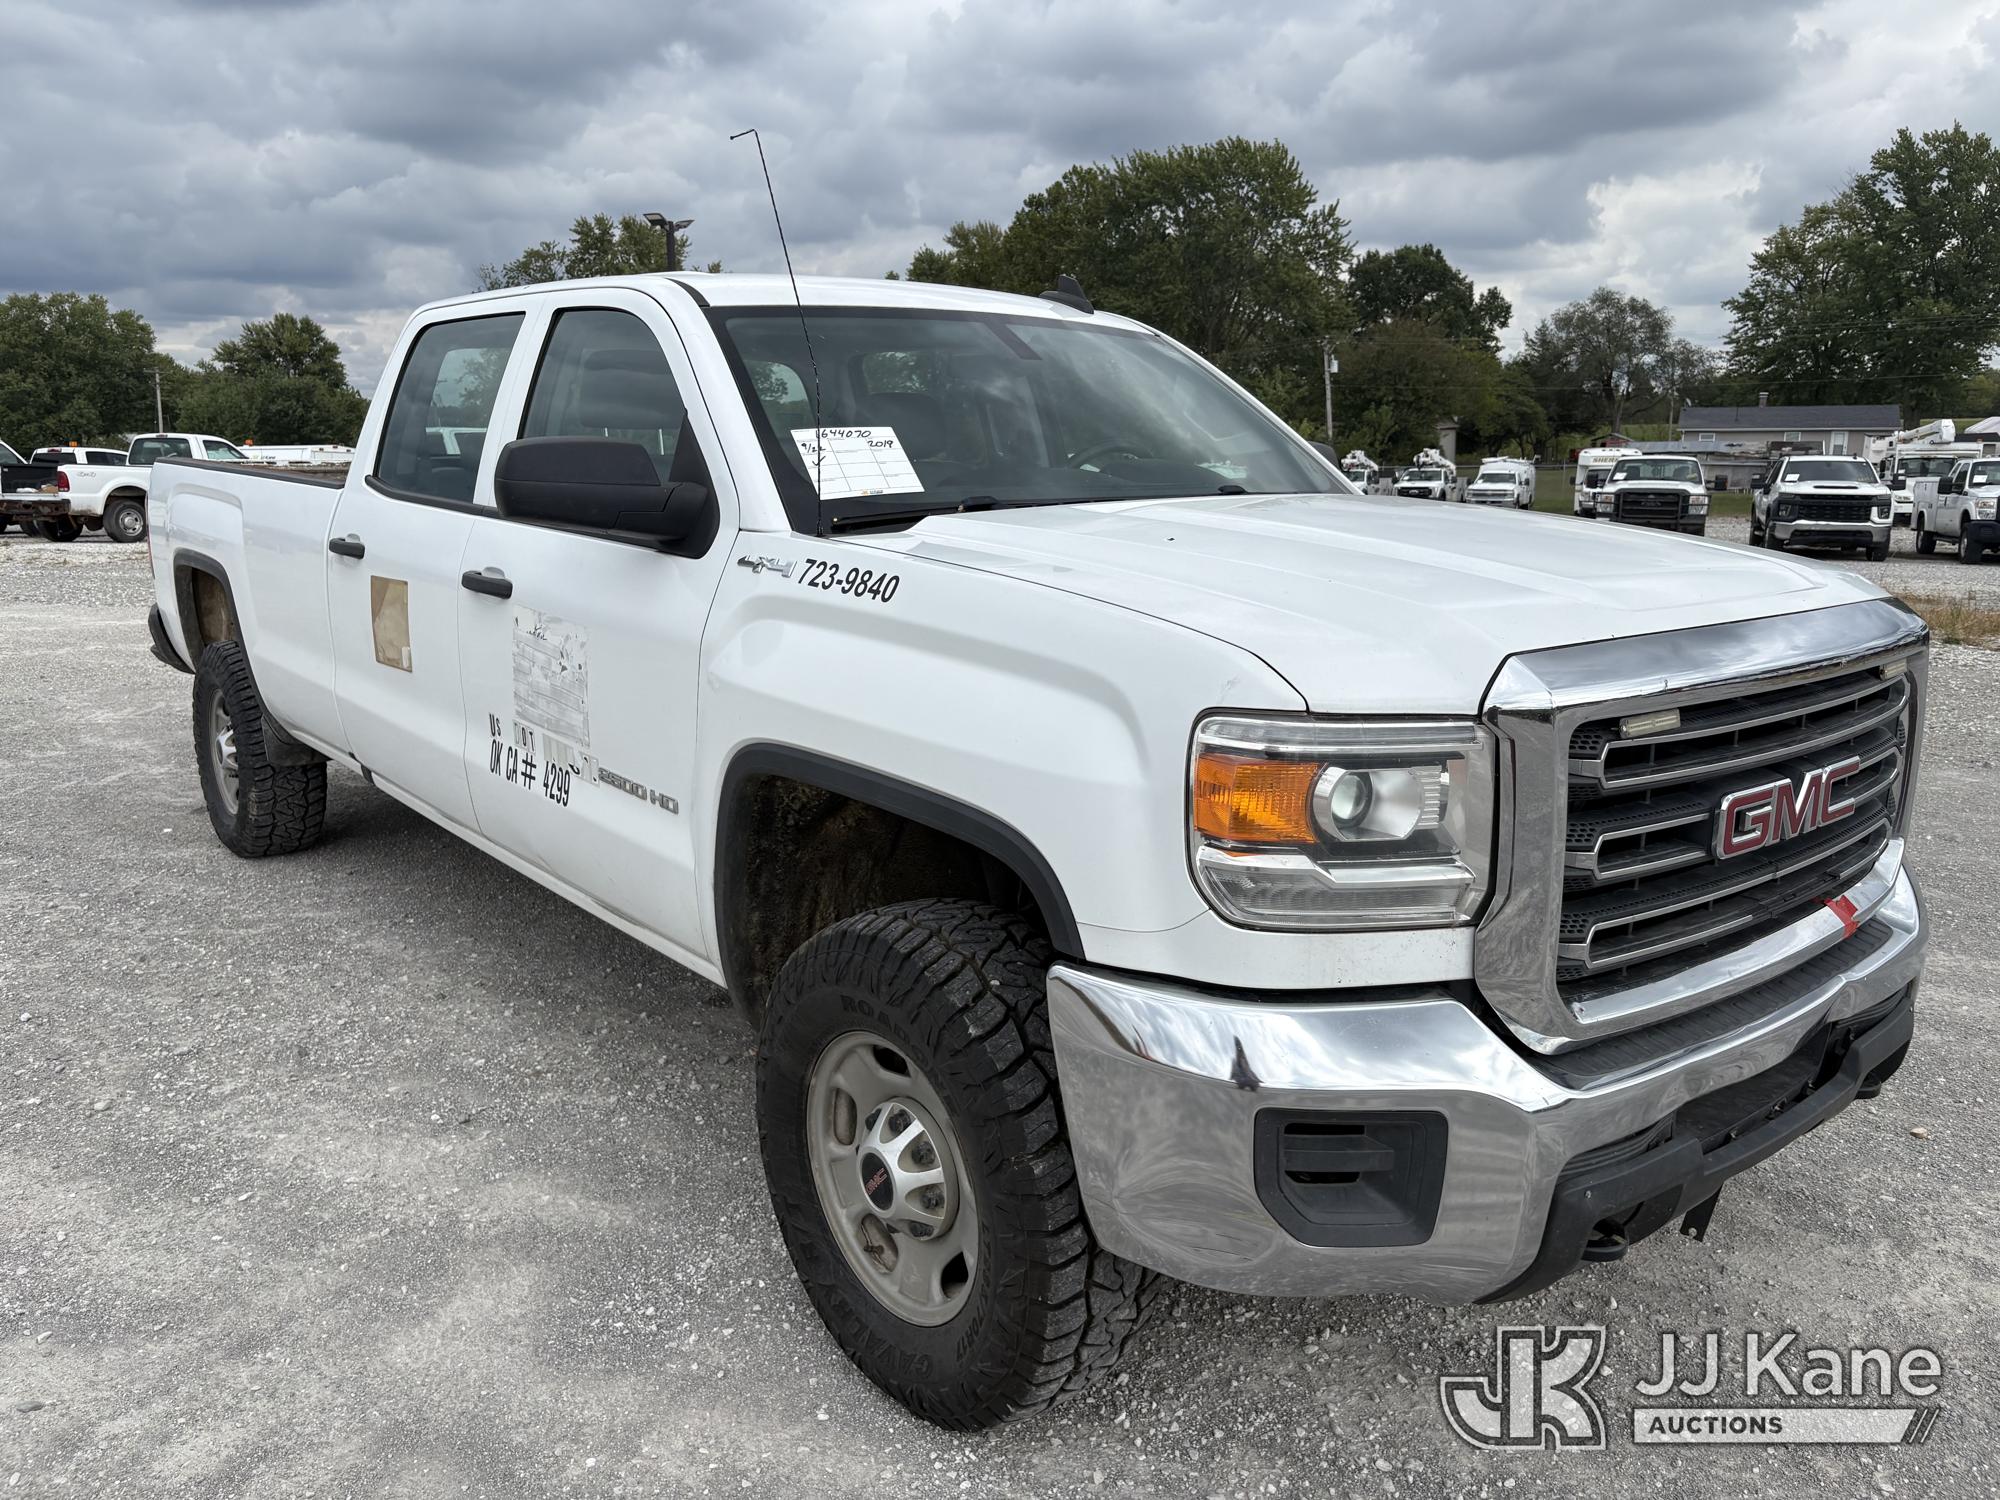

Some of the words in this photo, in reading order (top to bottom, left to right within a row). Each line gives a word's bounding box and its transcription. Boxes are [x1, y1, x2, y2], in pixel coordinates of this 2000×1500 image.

[867, 440, 894, 448] 2019
[798, 558, 900, 603] 723-9840
[489, 713, 502, 737] US
[490, 738, 503, 776] OK
[506, 746, 518, 784] CA
[543, 760, 571, 807] 4299
[1716, 755, 1861, 860] GMC
[866, 1167, 888, 1195] GMC
